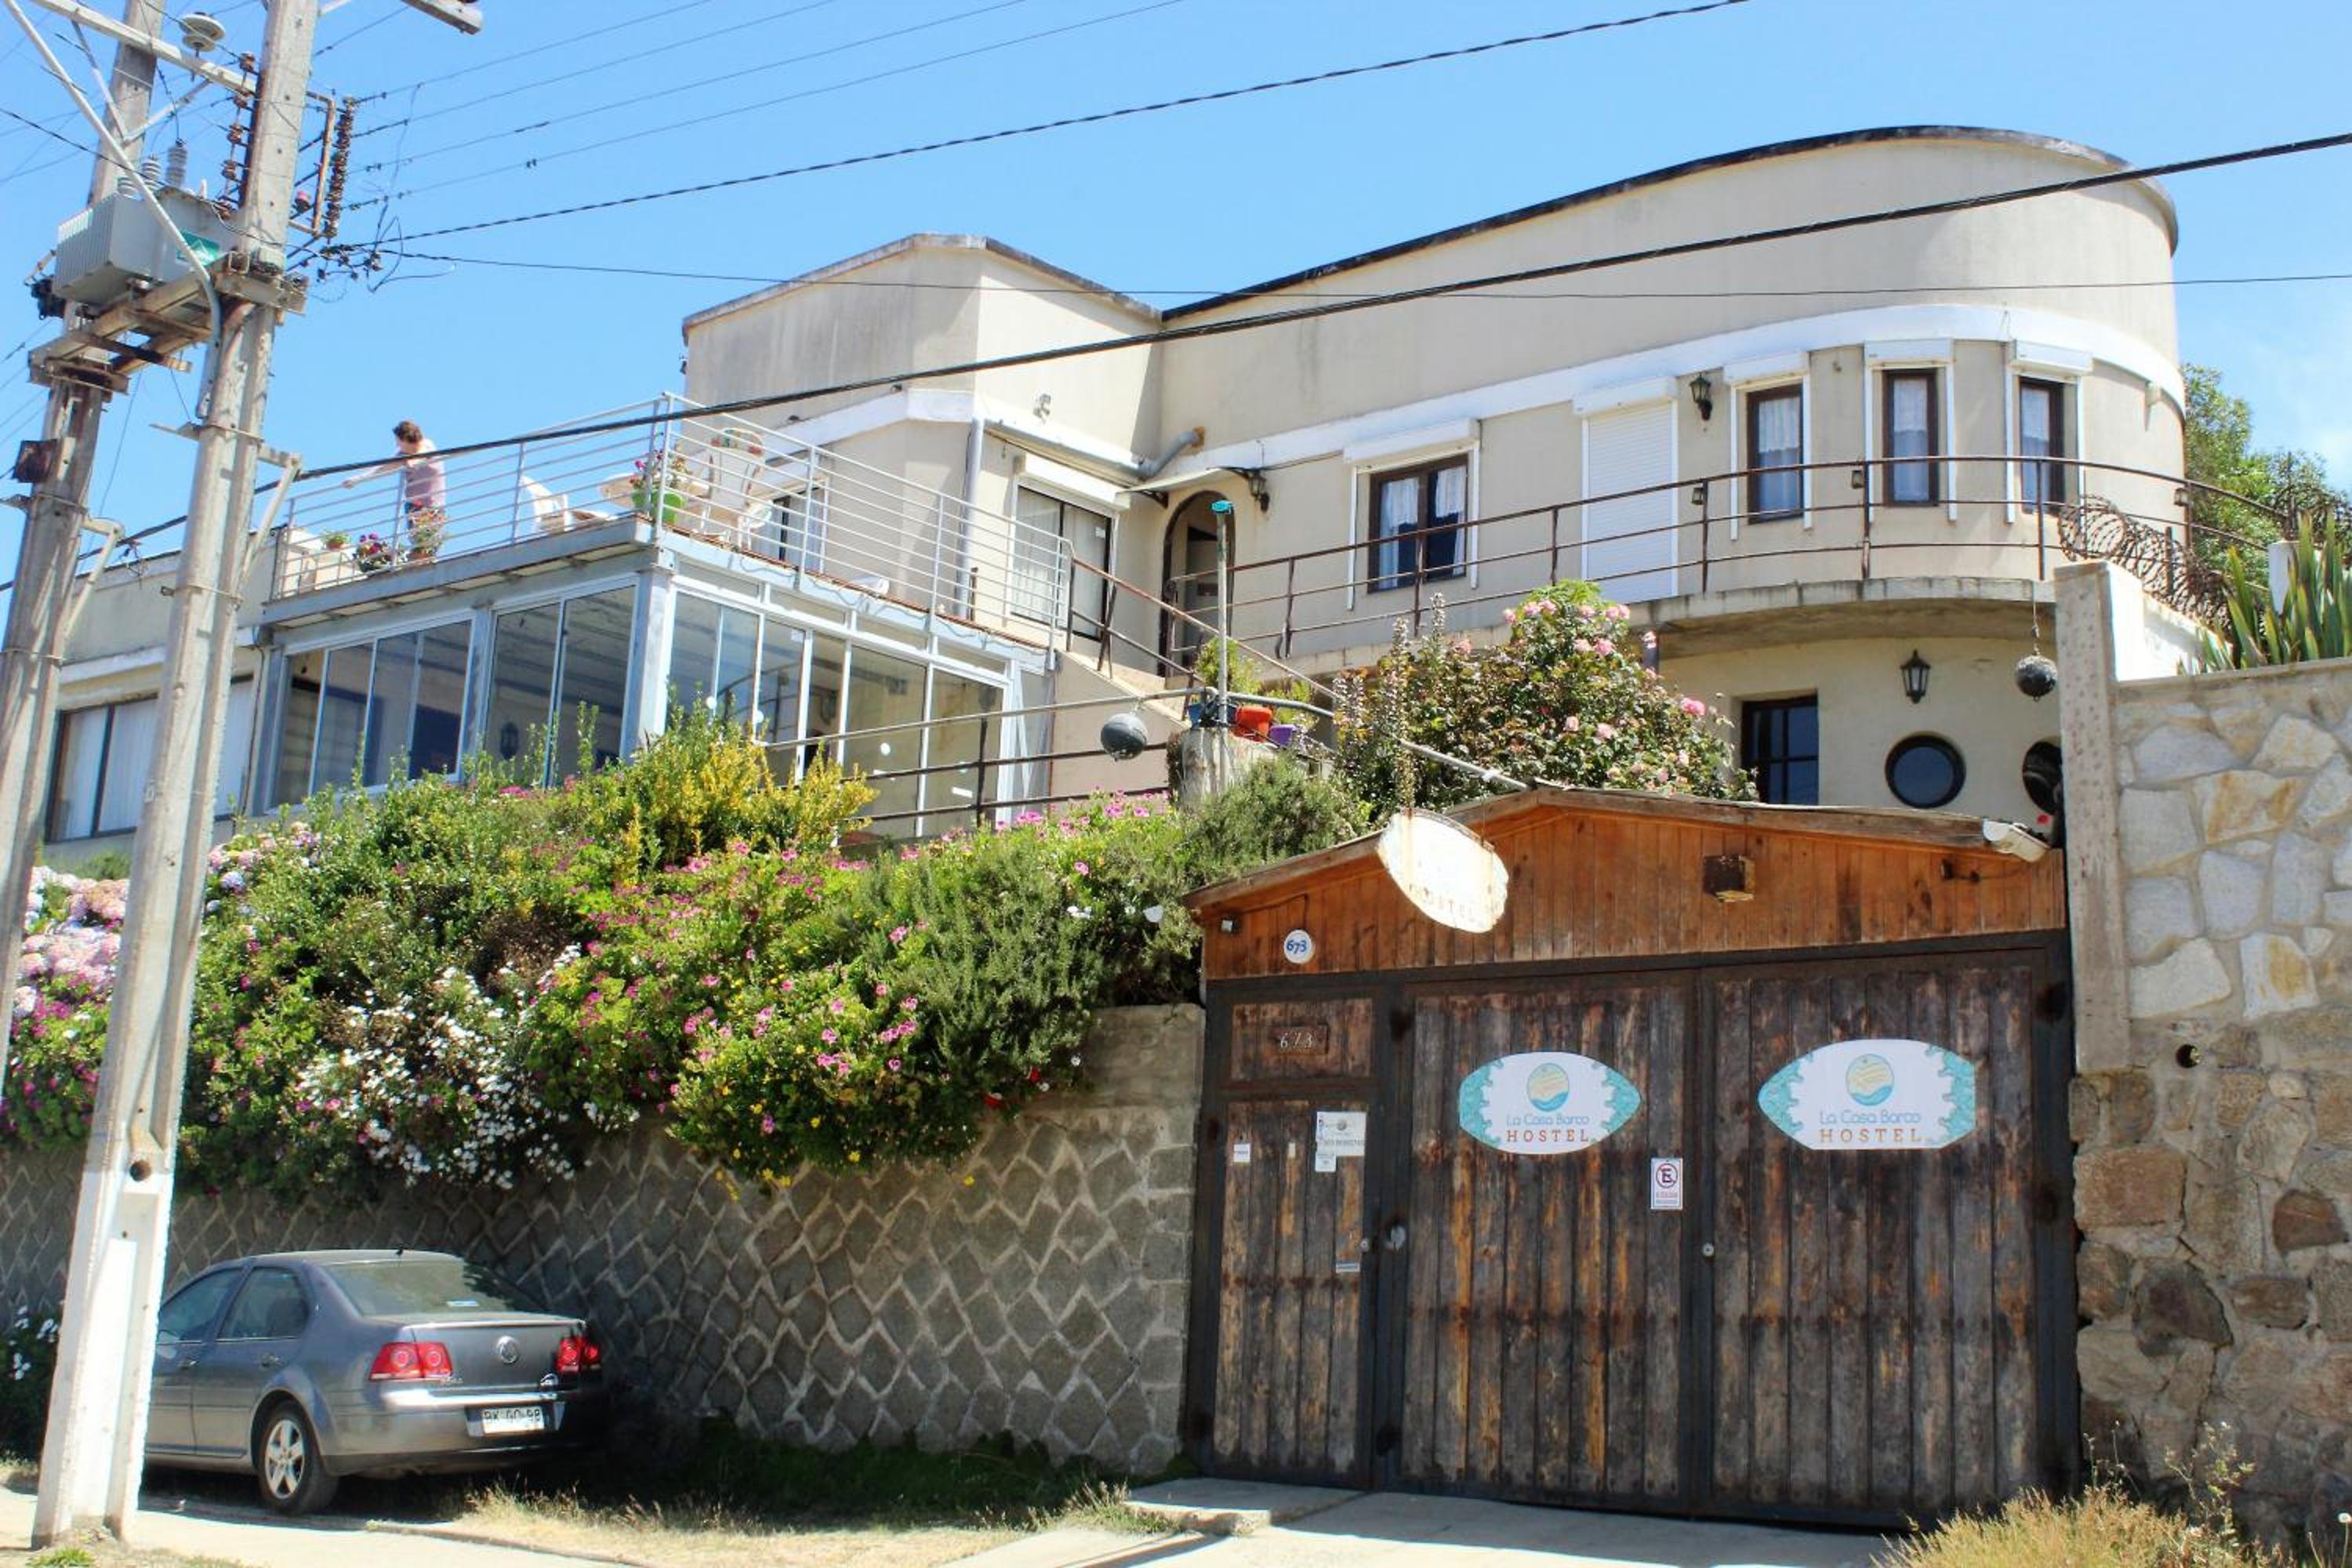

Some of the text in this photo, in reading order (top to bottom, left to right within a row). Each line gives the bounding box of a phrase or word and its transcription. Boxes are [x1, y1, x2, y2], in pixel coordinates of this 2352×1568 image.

[1286, 940, 1307, 954] 673
[1279, 1032, 1313, 1048] 673
[1506, 1115, 1590, 1126] La Casa Barco
[1819, 1109, 1921, 1124] La Casa Barco
[1506, 1129, 1589, 1142] HOSTEL
[1820, 1128, 1921, 1142] HOSTEL
